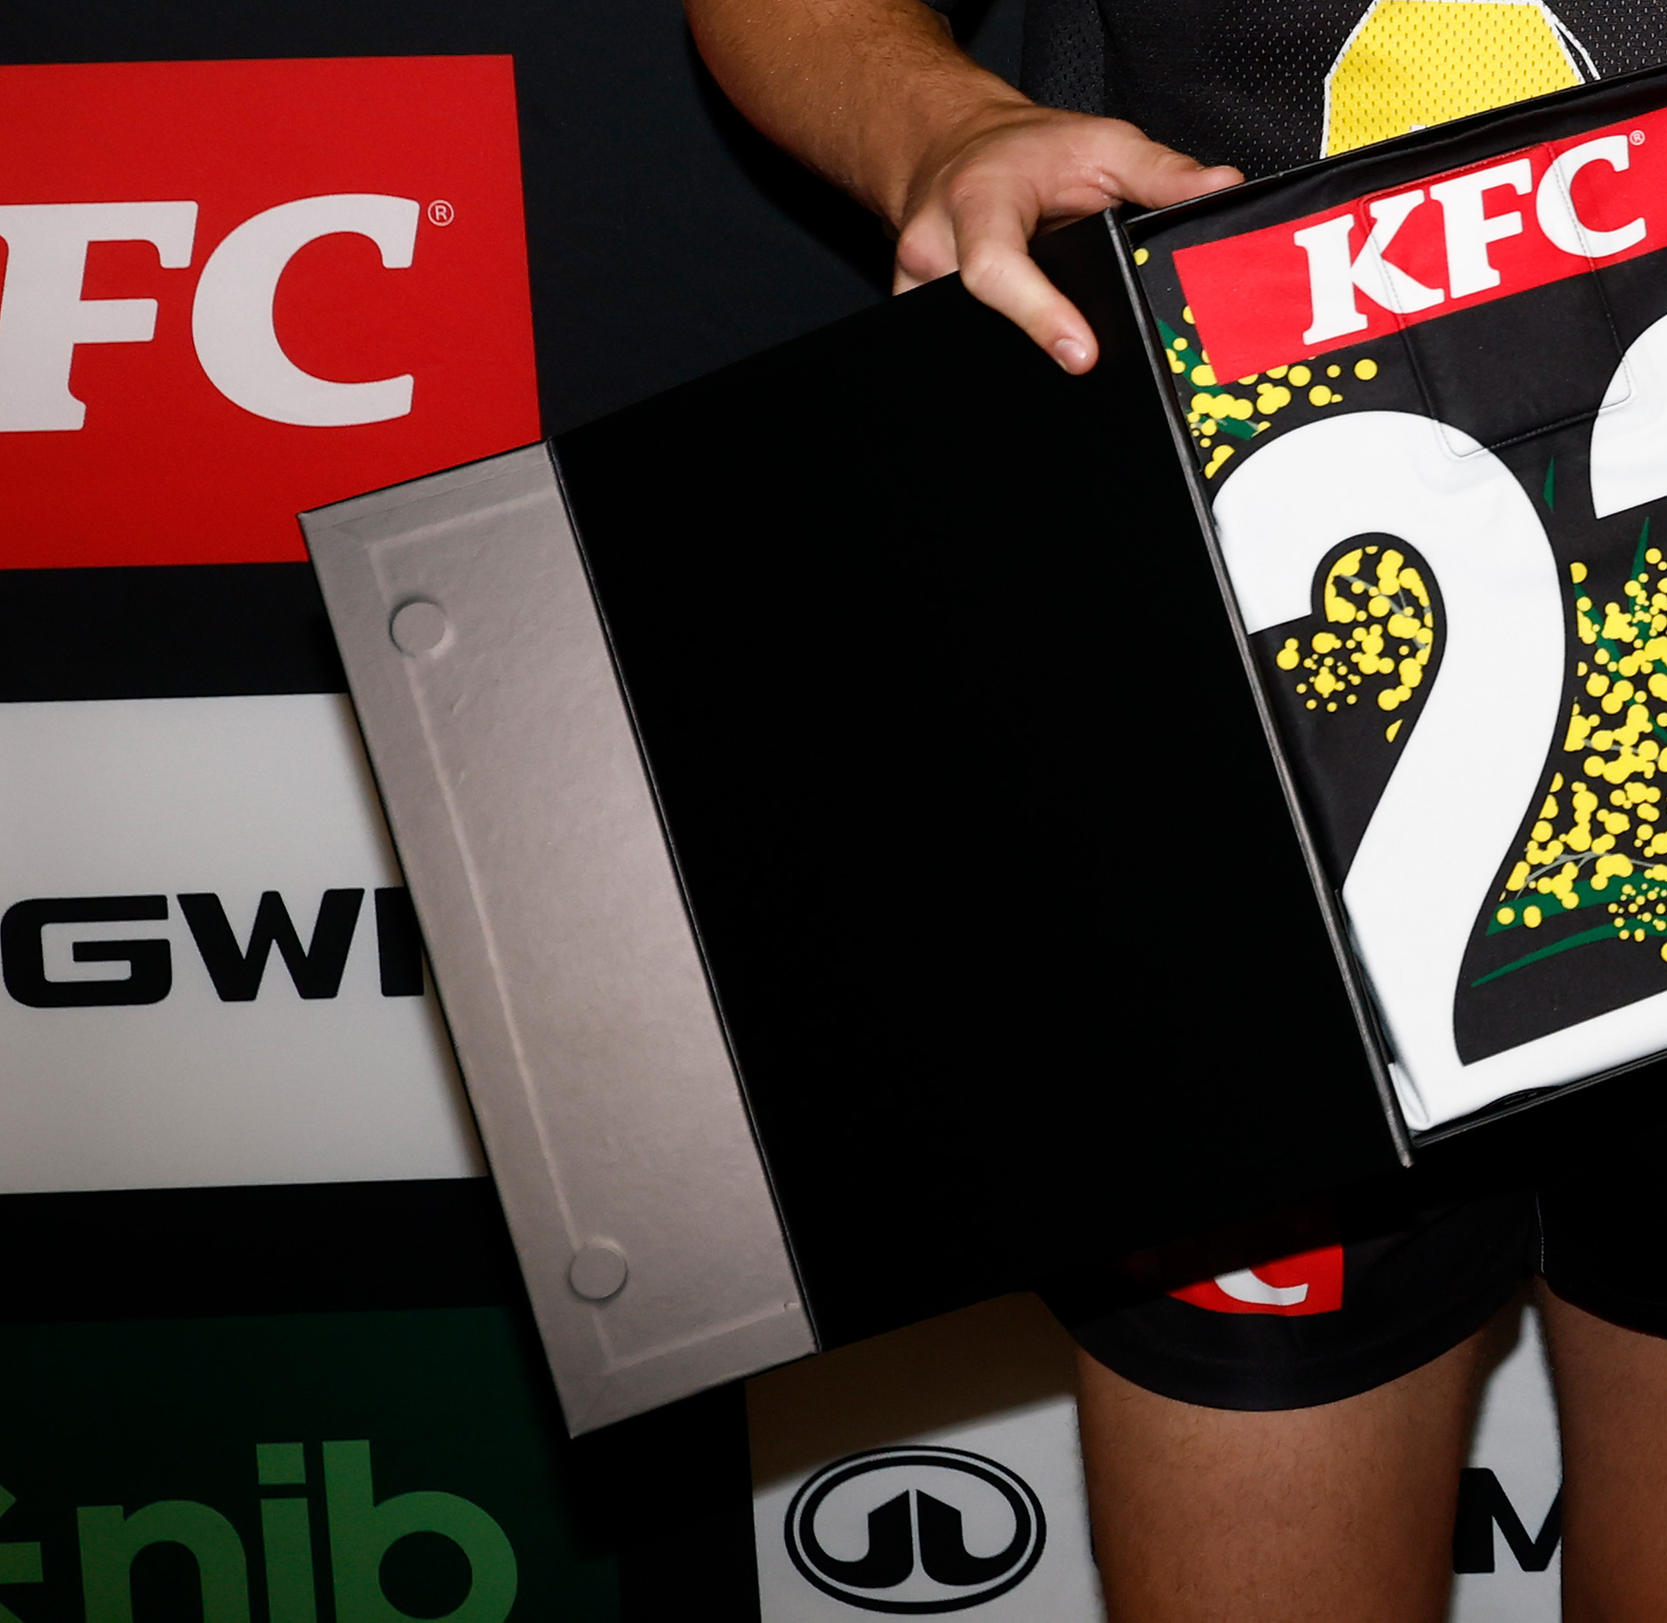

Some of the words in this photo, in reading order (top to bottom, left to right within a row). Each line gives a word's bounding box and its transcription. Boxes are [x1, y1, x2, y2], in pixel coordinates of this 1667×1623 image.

[0, 193, 421, 432] FC
[1293, 133, 1647, 347] KFC
[76, 1438, 518, 1623] nib
